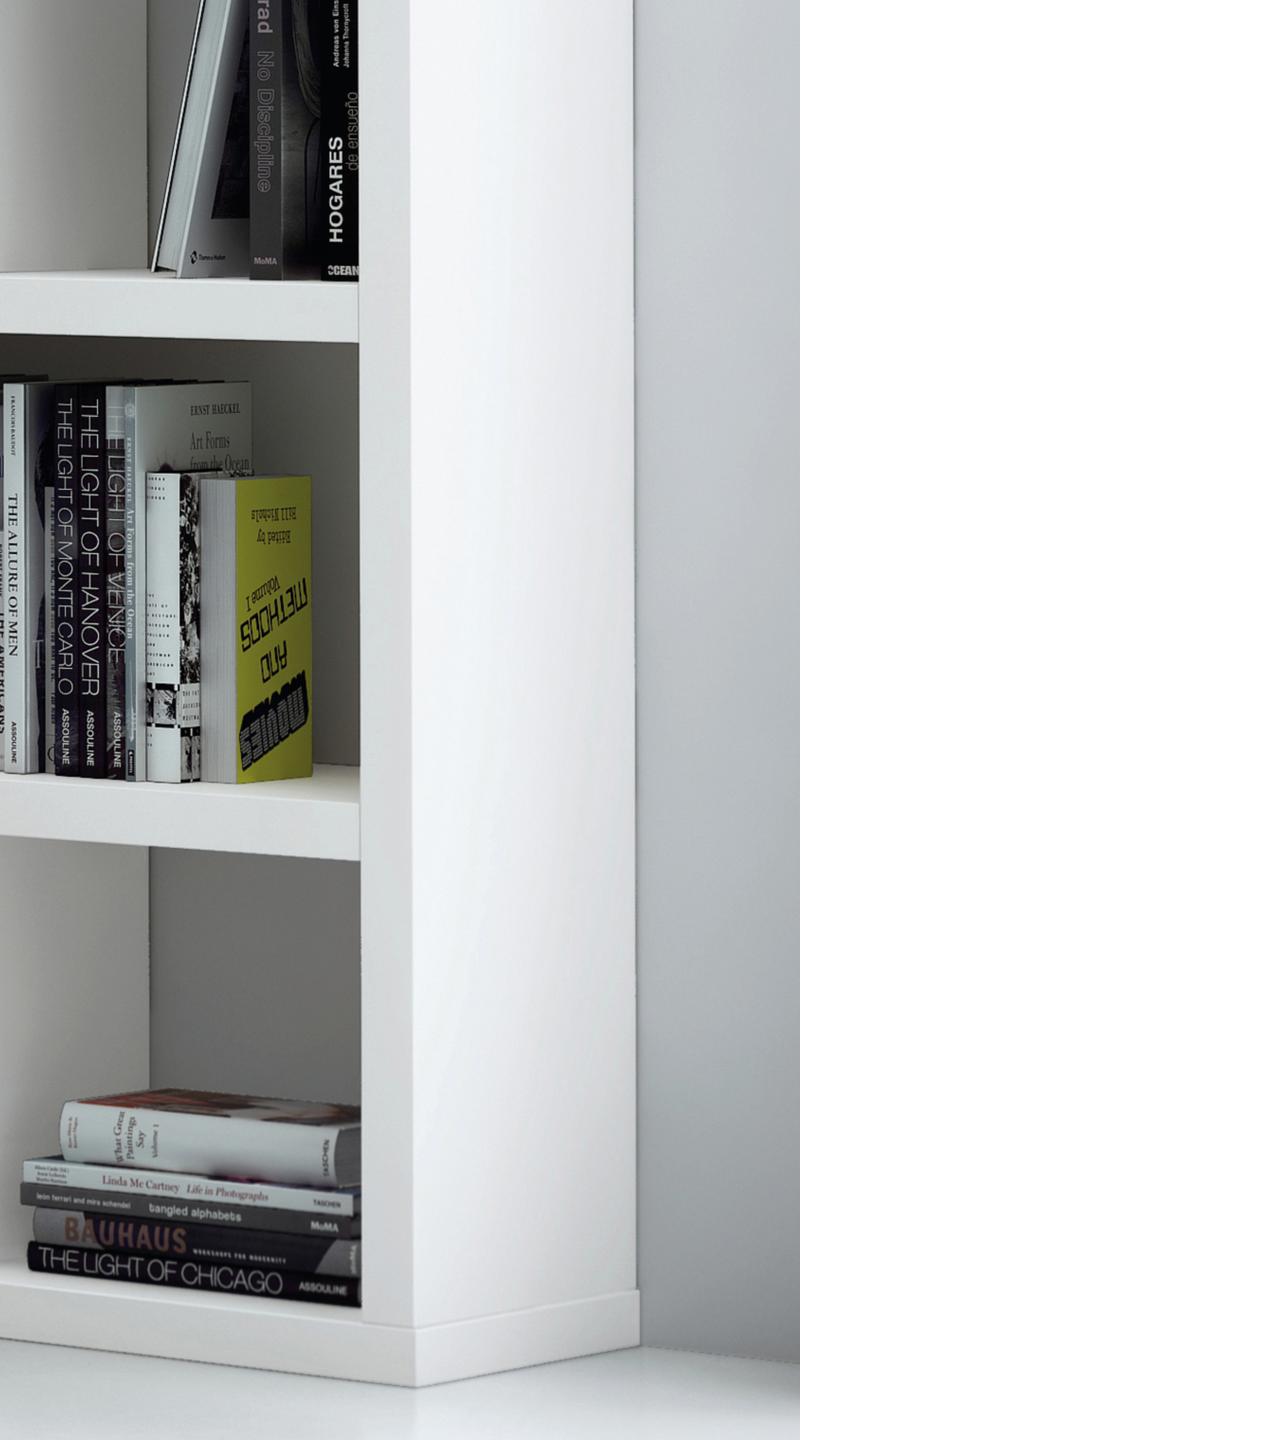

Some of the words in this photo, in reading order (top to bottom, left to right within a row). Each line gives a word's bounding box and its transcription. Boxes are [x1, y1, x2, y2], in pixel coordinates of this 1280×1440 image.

[328, 136, 343, 243] HOGARES
[102, 1175, 127, 1186] Linda
[129, 1177, 143, 1188] Mc
[145, 1180, 178, 1194] Cartney
[186, 1184, 202, 1194] Life
[215, 1187, 268, 1202] Photographs
[149, 1202, 188, 1217] tangled
[191, 1206, 242, 1222] alphabets
[64, 1217, 187, 1254] BAUHAUS
[39, 1246, 79, 1271] THE
[83, 1252, 144, 1277] LIGHT
[146, 1258, 177, 1281] OF
[180, 1262, 282, 1294] CHICAGO
[299, 1282, 347, 1295] ASSOULINE
